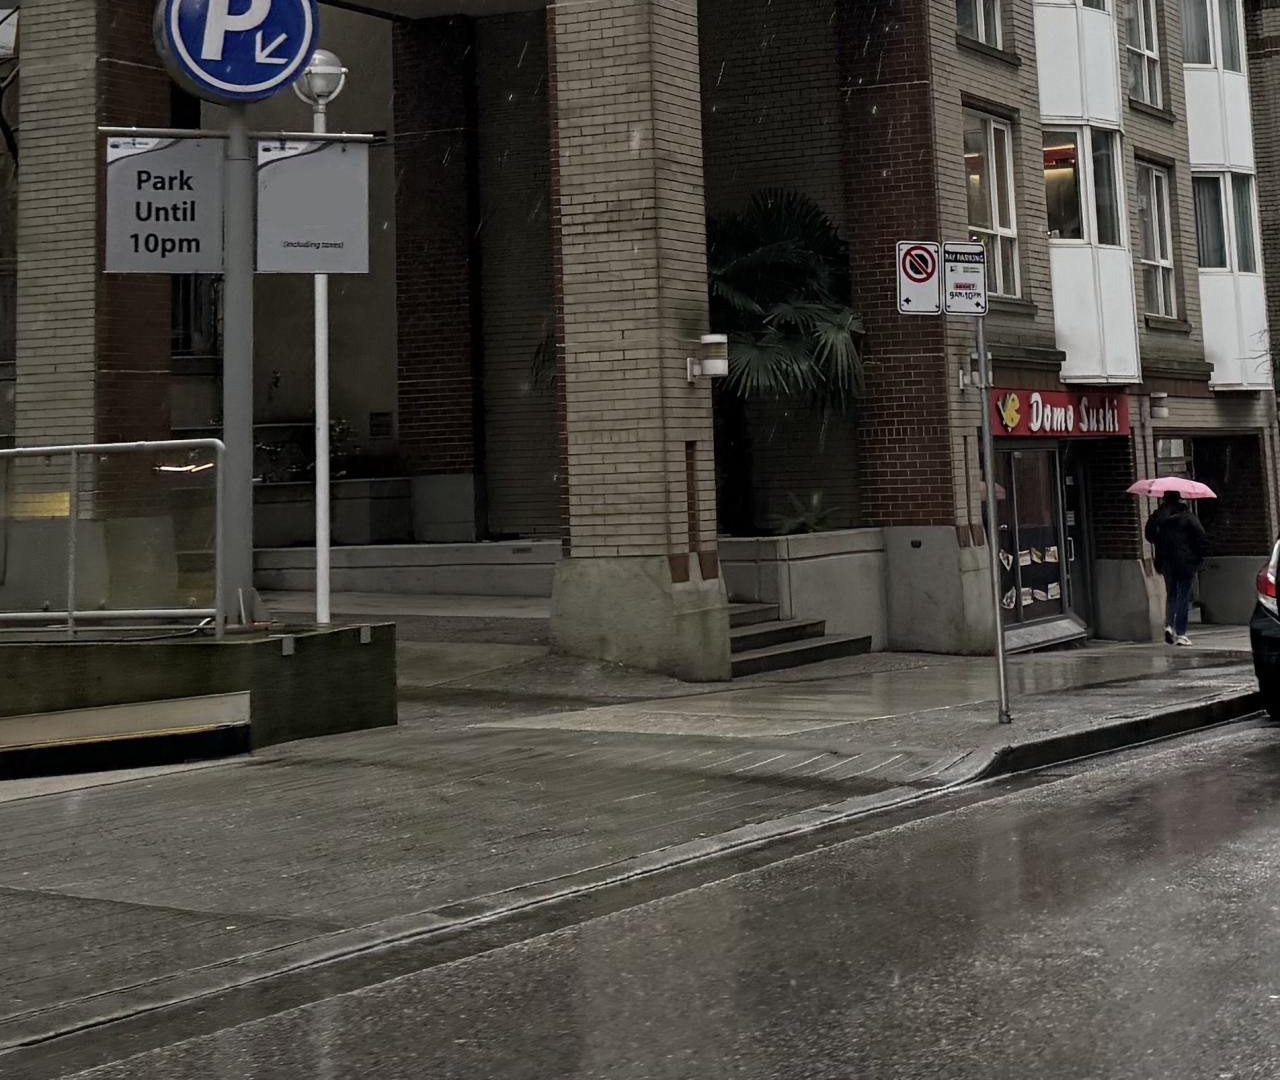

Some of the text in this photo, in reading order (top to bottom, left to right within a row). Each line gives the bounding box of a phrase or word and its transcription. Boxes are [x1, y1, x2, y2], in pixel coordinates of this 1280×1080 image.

[136, 170, 194, 191] Park
[135, 200, 196, 222] Until
[130, 233, 201, 258] 10pm
[957, 253, 984, 262] PARKING
[1029, 392, 1119, 432] Domo Sushi
